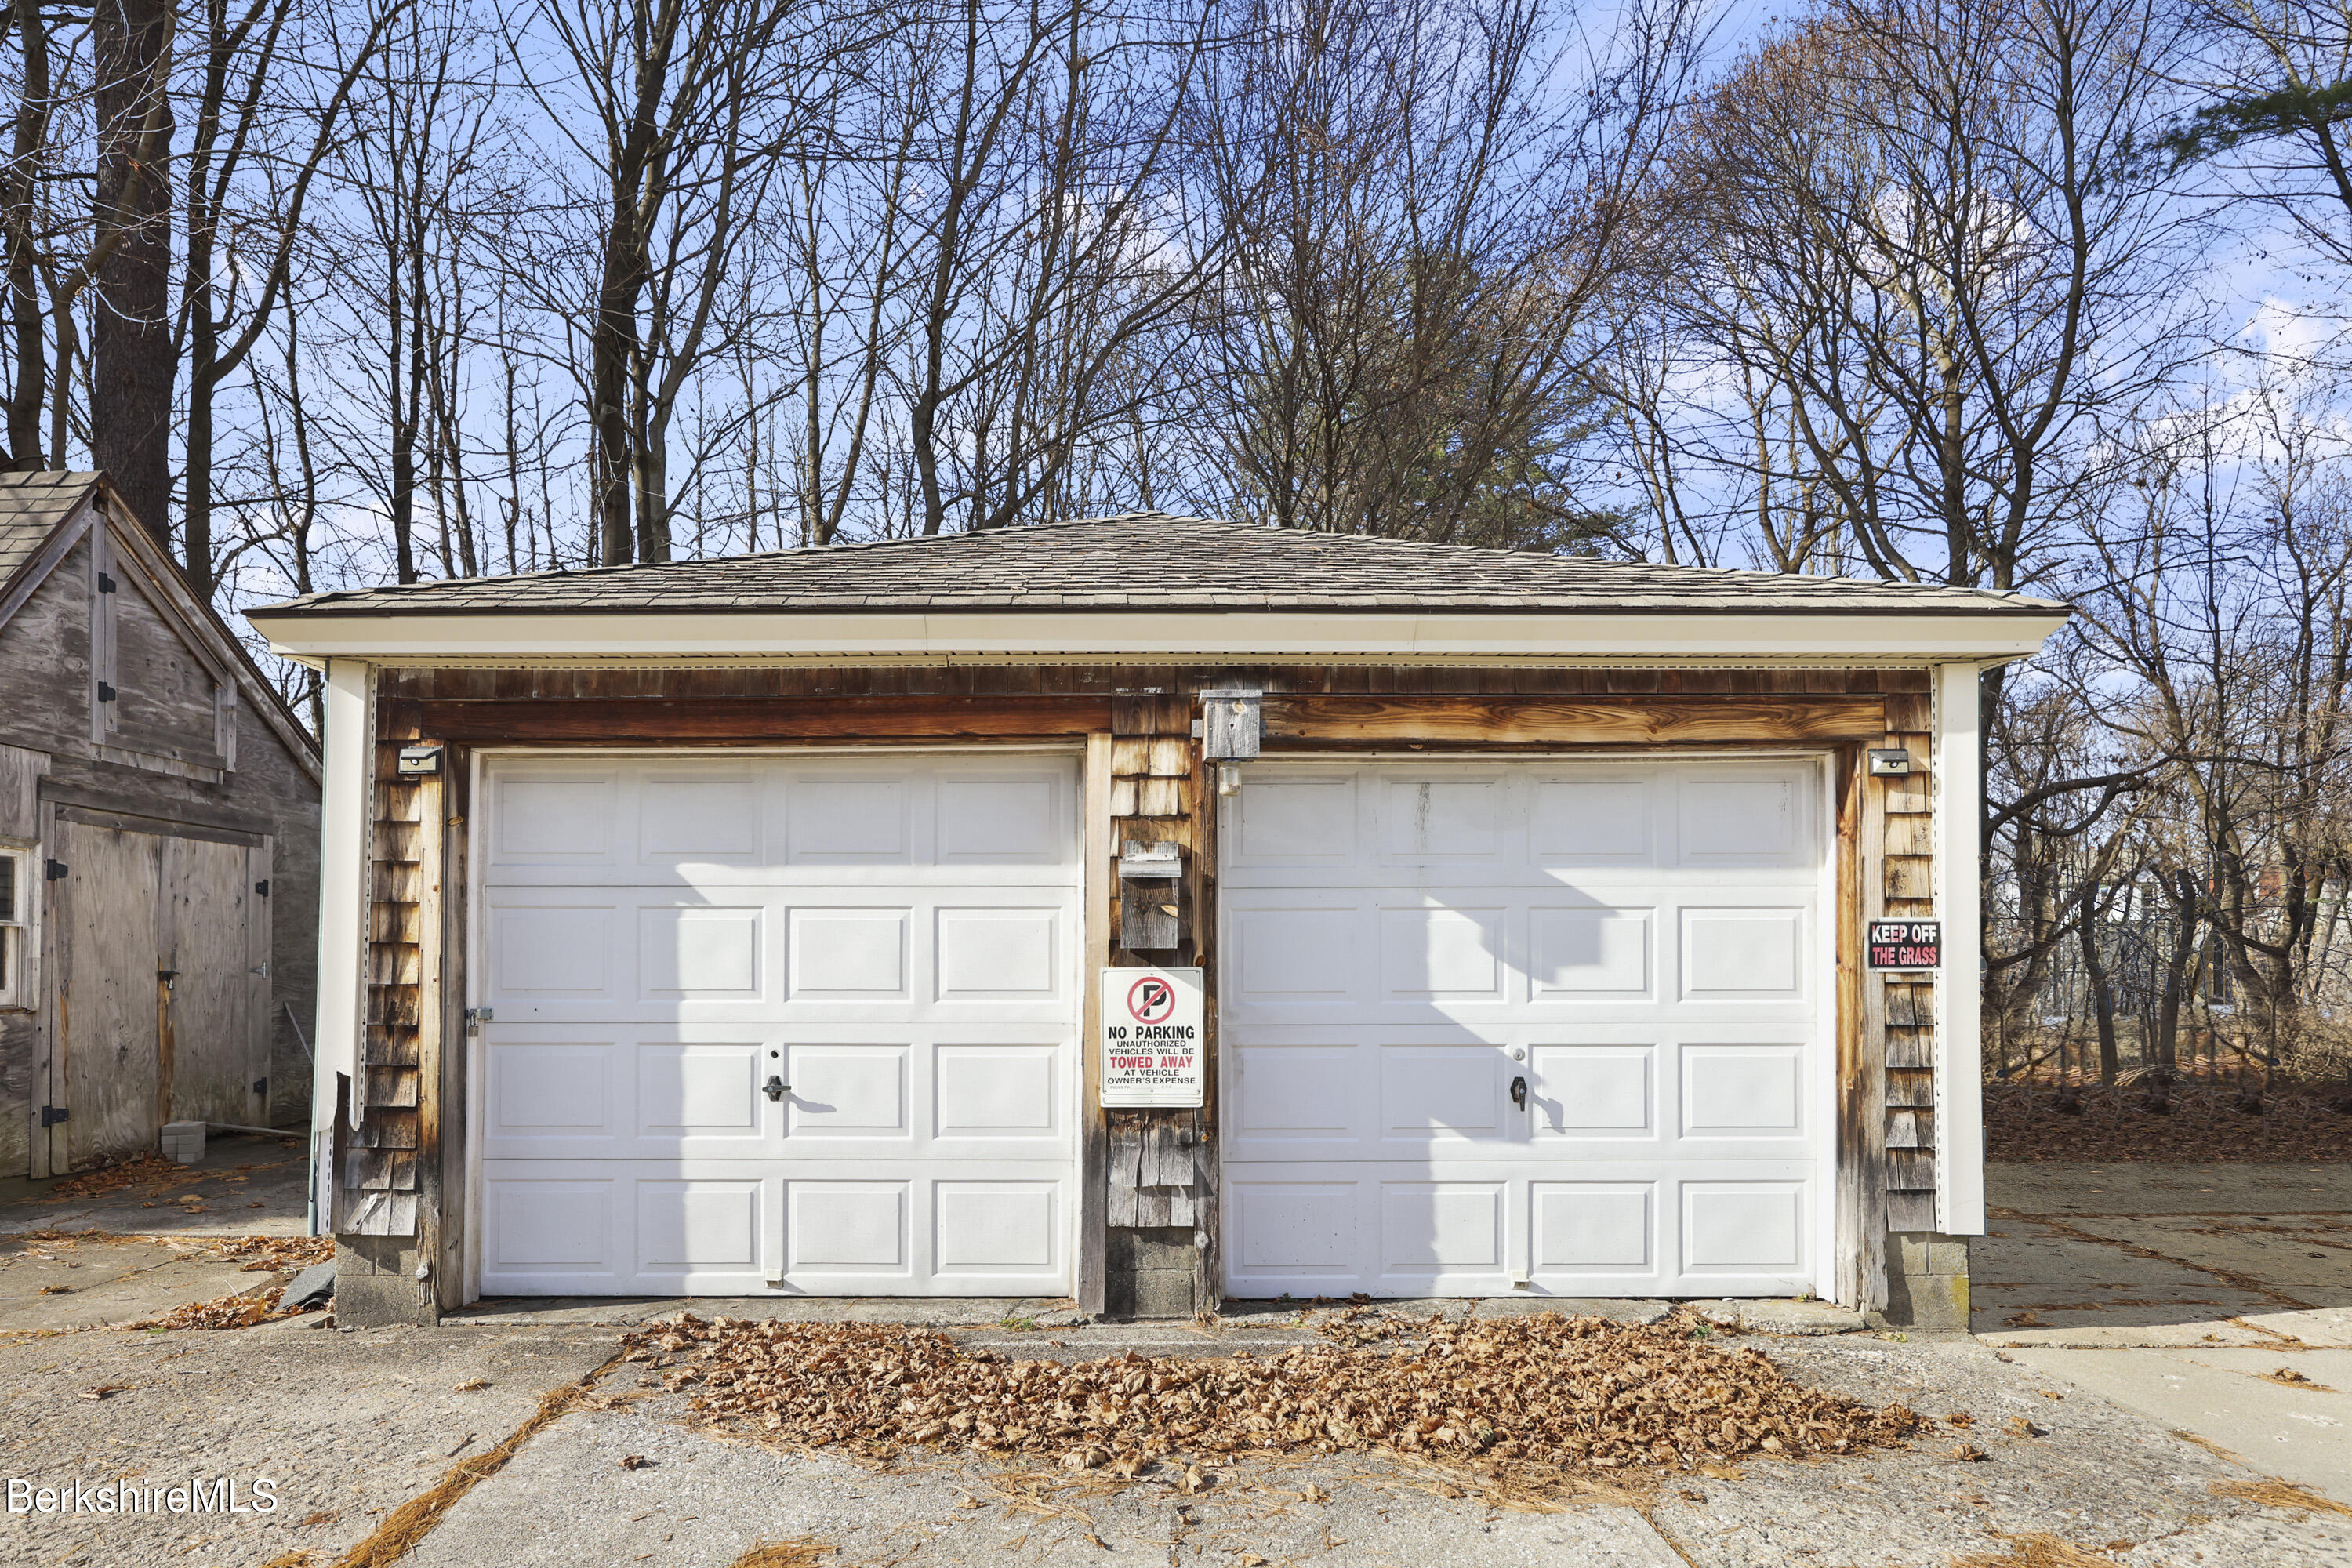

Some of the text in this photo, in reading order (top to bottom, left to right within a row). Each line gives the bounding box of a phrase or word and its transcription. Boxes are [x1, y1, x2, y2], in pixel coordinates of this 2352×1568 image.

[1871, 924, 1936, 943] KEEP OFF
[1872, 946, 1937, 965] THE GRASS
[1143, 985, 1167, 1017] P
[1108, 1025, 1195, 1039] NO PARKING
[1109, 1056, 1193, 1069] TOWED AWAY
